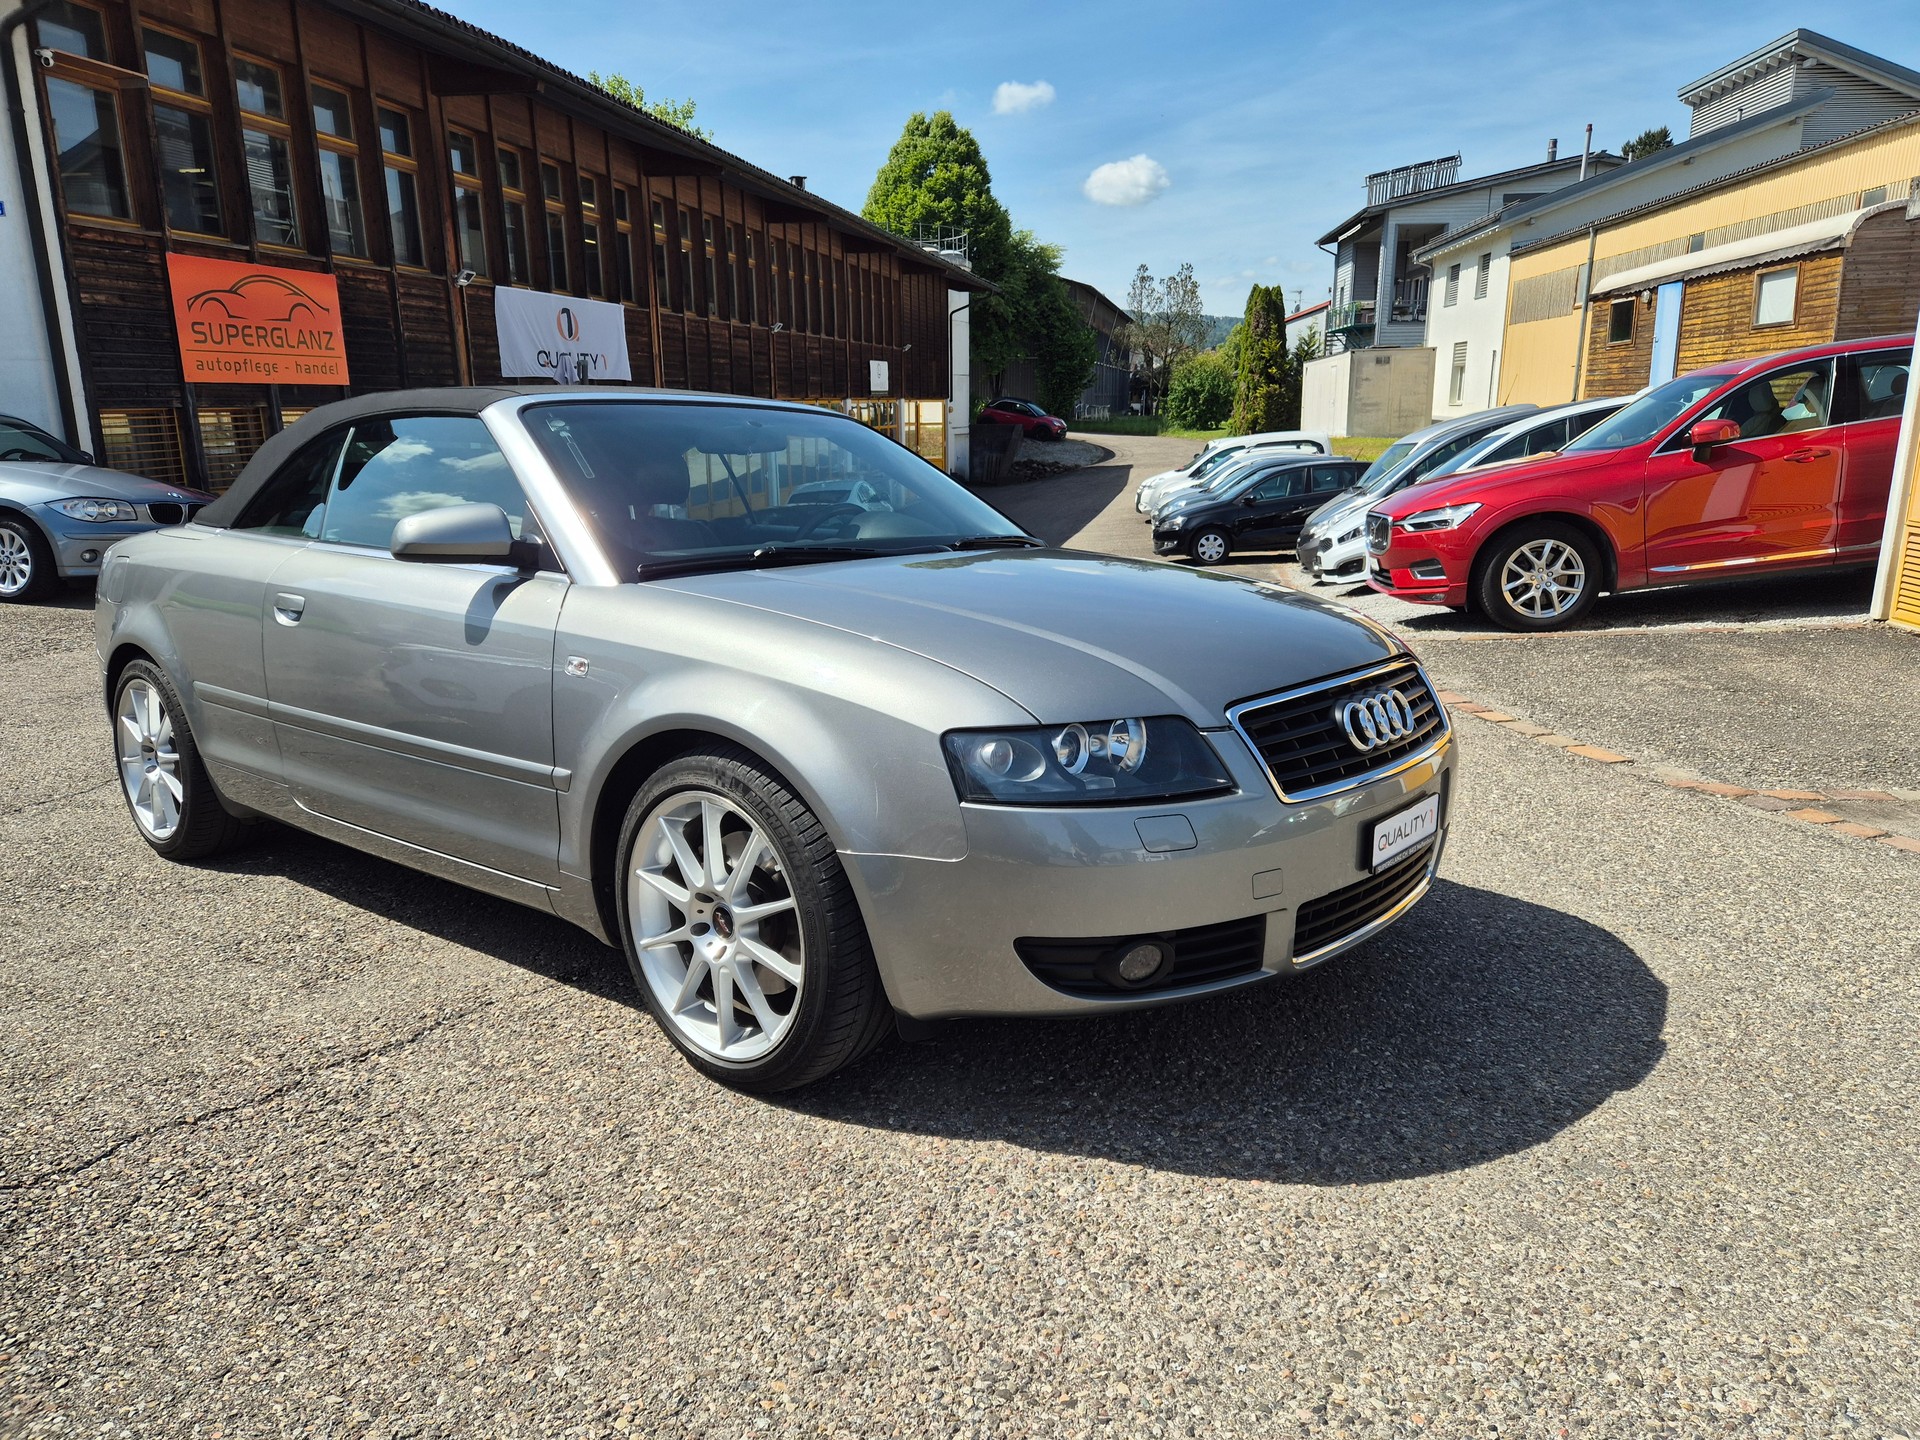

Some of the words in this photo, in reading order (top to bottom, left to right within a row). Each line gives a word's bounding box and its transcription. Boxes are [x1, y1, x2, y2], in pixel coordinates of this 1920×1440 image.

[191, 321, 335, 351] SUPERGLANZ
[195, 357, 278, 376] autopflege
[294, 360, 339, 376] handel
[744, 790, 803, 866] MICHELIN
[1378, 811, 1428, 851] QUALITY
